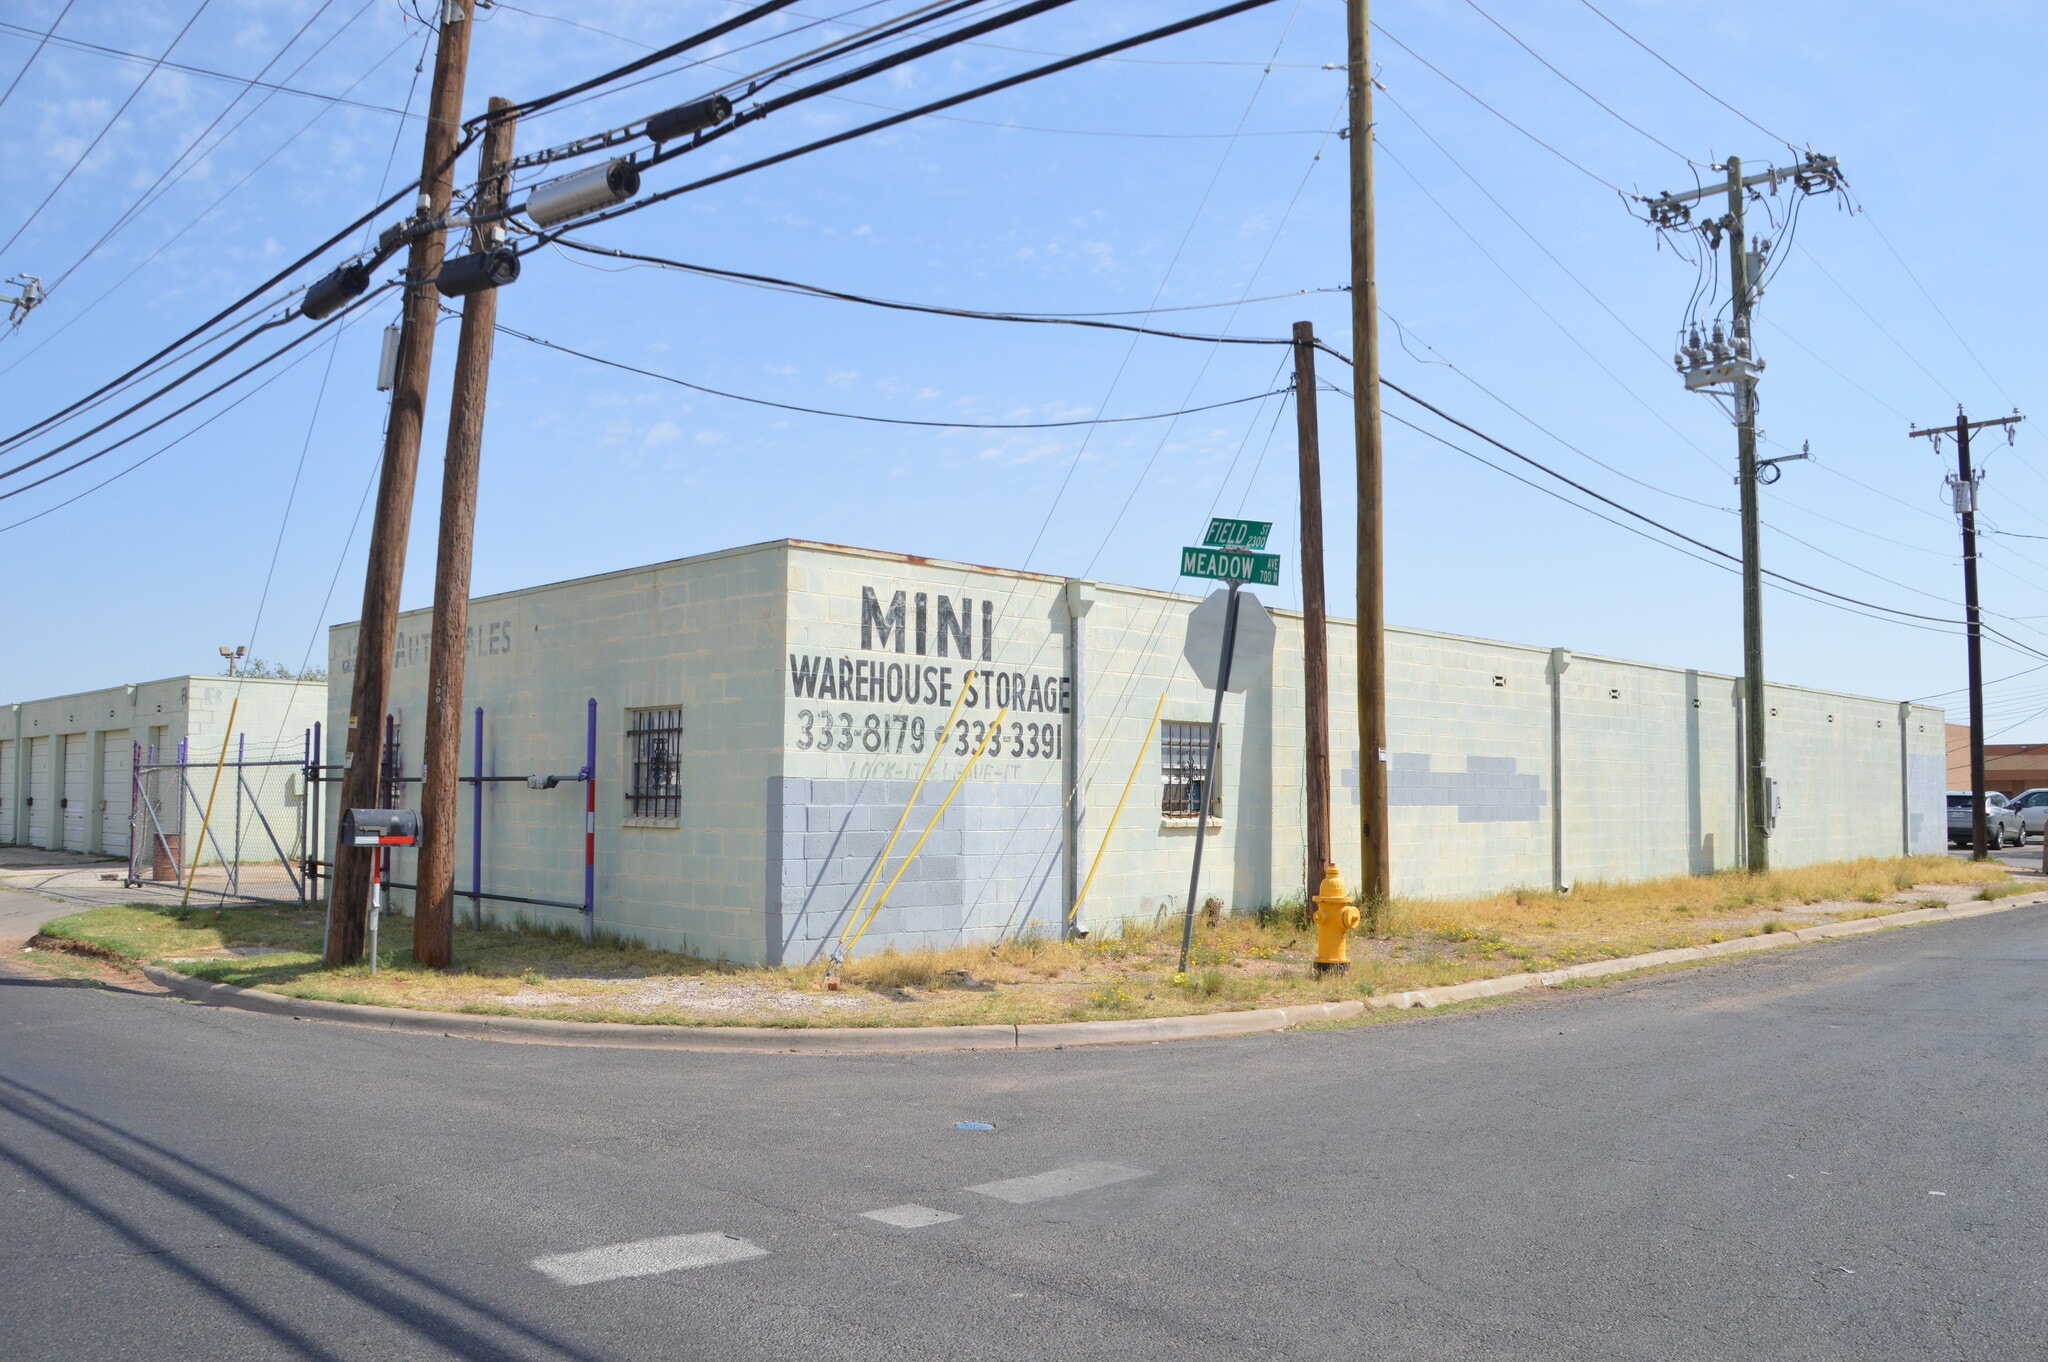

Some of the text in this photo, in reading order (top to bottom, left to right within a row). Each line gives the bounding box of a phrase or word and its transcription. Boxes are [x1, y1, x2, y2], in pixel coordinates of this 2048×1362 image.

[1205, 521, 1271, 544] FIELD ST
[1246, 535, 1266, 548] 2300
[1183, 552, 1254, 579] MEADOW
[1260, 570, 1278, 583] 700 N
[1266, 558, 1279, 570] AVE
[861, 585, 994, 662] MINI
[394, 631, 431, 669] AUT
[466, 620, 512, 658] ALES
[789, 653, 1070, 714] WAREHOUSE STORAGE
[796, 709, 1062, 760] 333-8179 333-3391
